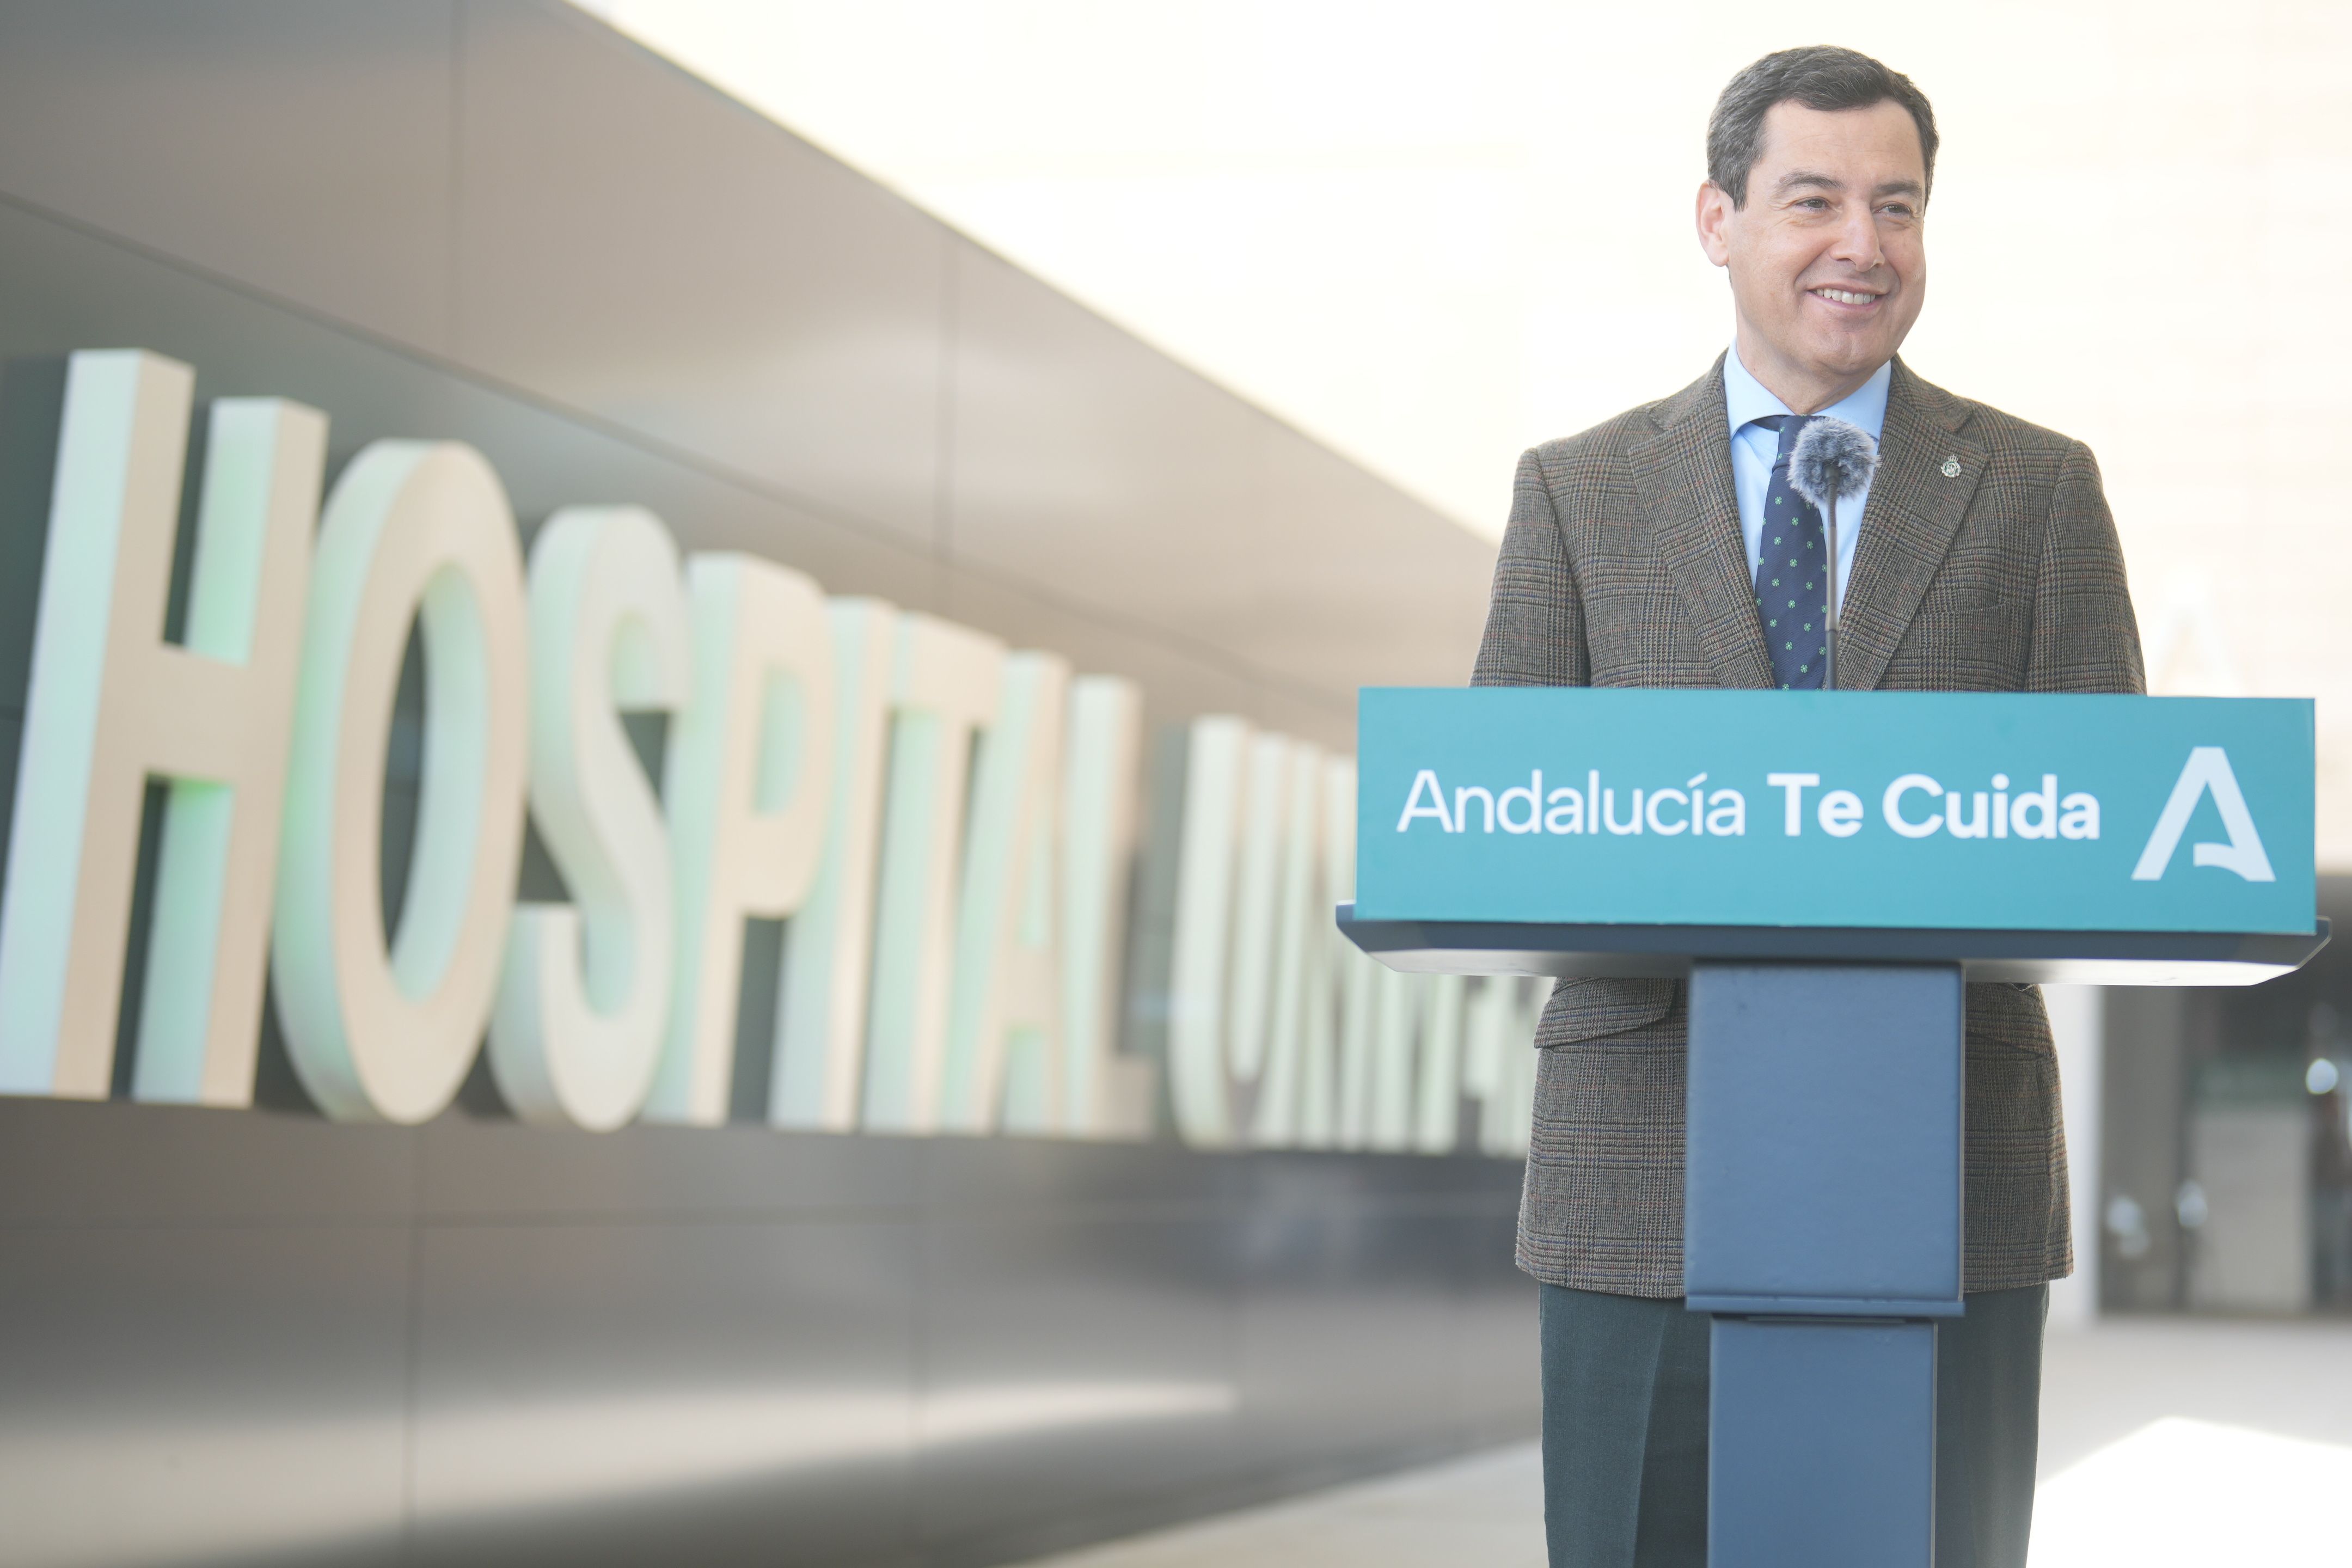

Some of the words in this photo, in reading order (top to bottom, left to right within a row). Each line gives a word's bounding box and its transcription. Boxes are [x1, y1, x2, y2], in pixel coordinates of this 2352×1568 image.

[0, 349, 1154, 1138] HOSPITAL
[1396, 768, 1746, 836] Andalucía
[1767, 773, 1864, 837] Te
[1882, 773, 2100, 840] Cuida
